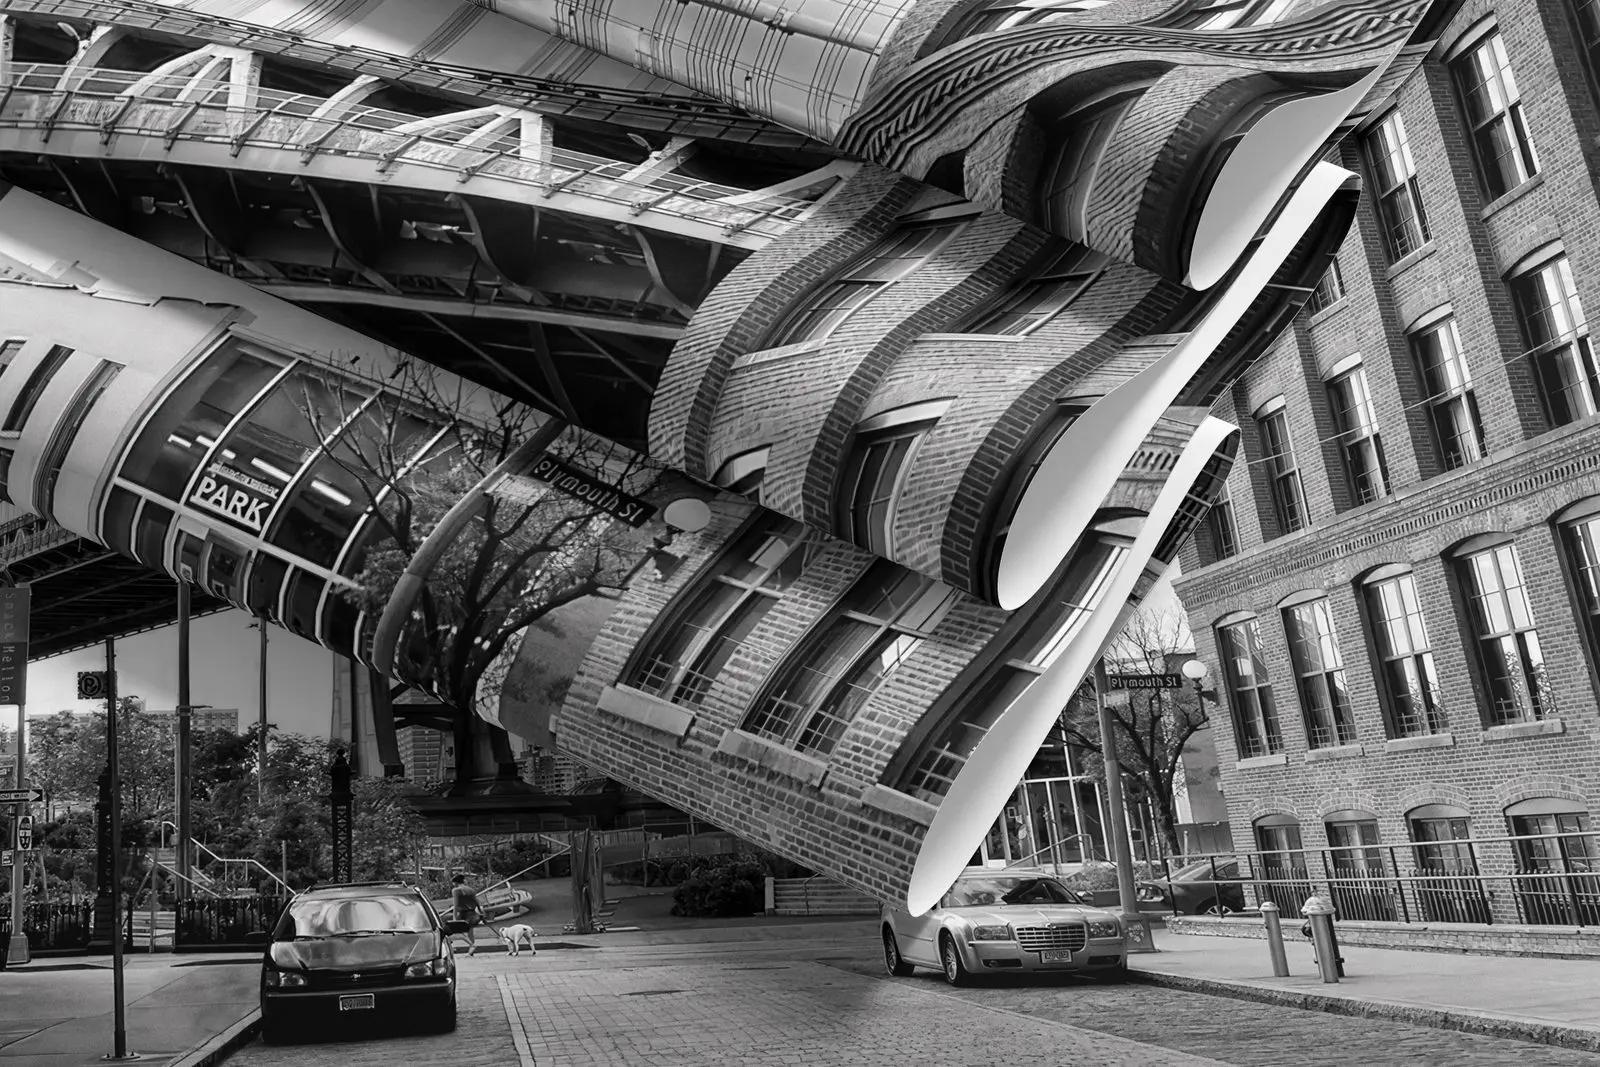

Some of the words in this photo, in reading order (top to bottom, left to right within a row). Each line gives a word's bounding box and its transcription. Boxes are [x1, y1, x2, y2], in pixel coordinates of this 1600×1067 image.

[190, 475, 270, 531] PARK
[534, 460, 619, 511] Plymouth
[618, 502, 645, 523] St
[1111, 676, 1164, 689] Plymouth
[1166, 676, 1177, 687] St
